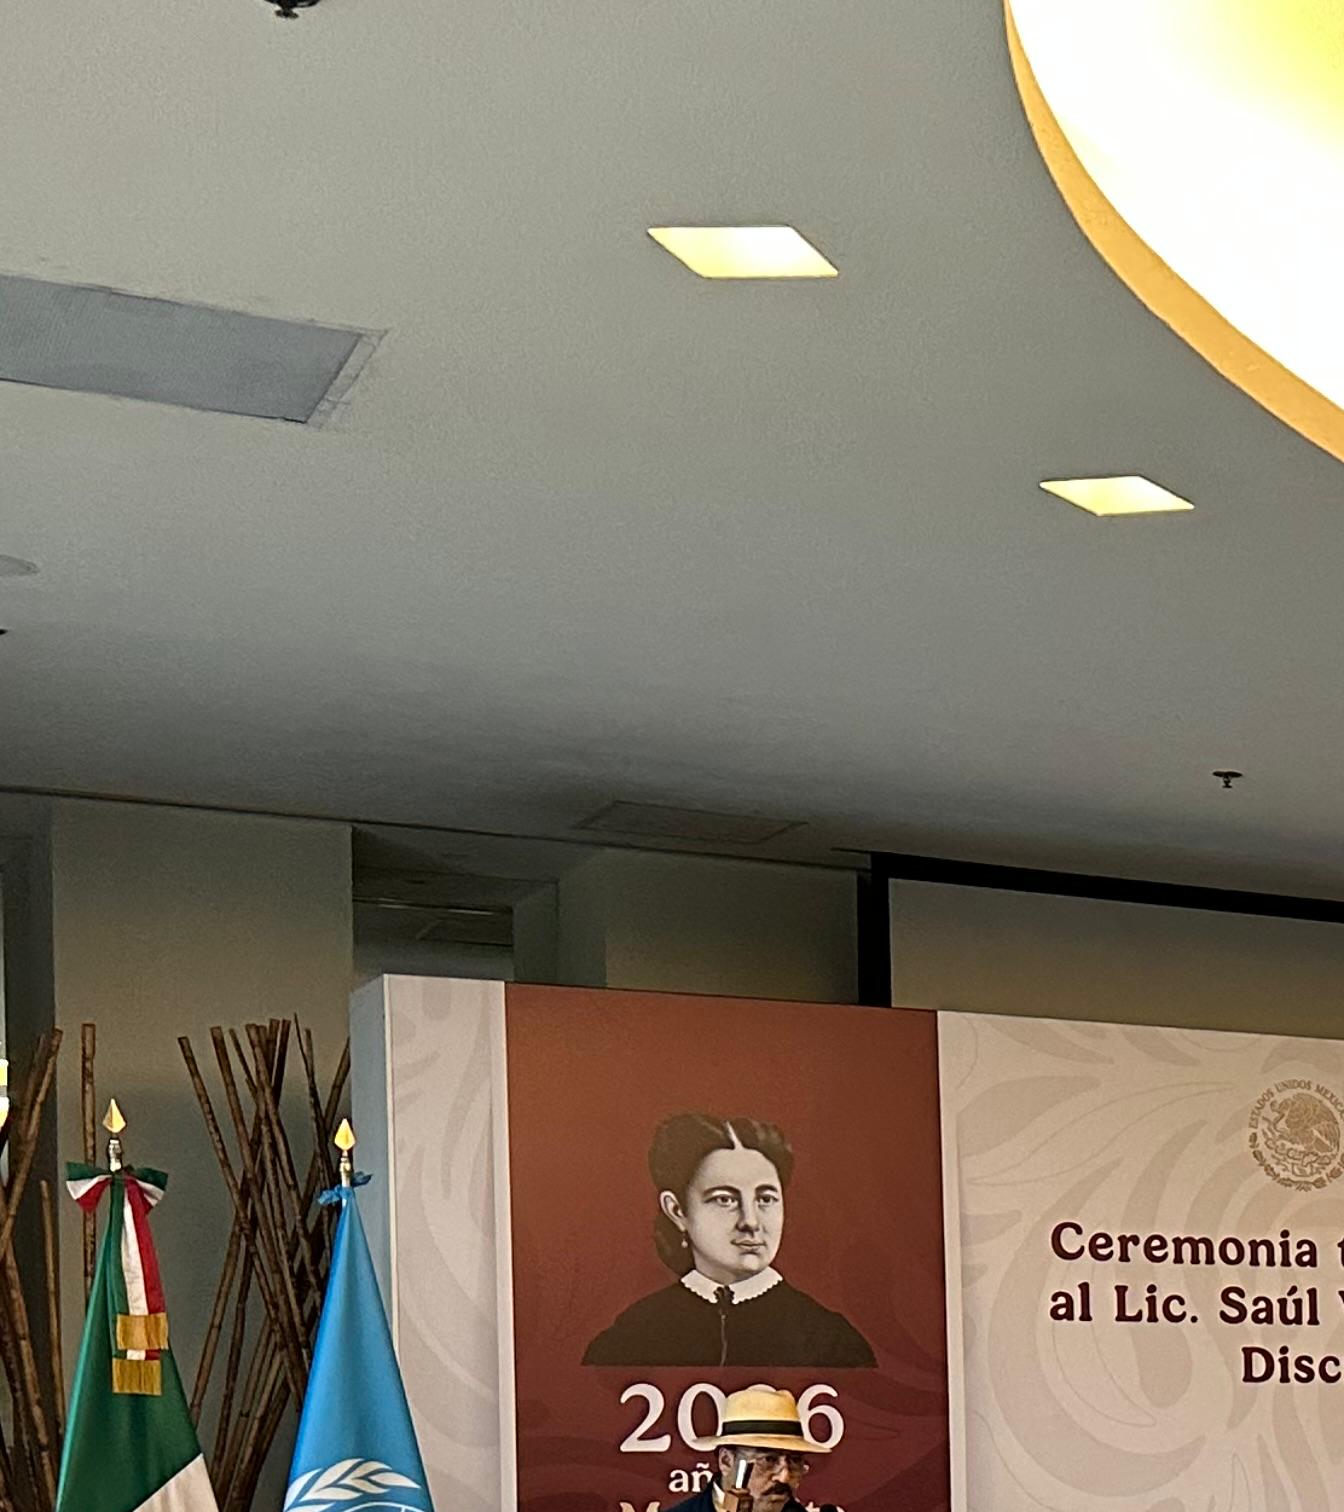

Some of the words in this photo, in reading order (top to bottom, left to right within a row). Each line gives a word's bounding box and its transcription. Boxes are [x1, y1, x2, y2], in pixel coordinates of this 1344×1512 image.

[1249, 1088, 1275, 1129] ESTADOS
[1275, 1079, 1313, 1092] UNIDOS
[1050, 1221, 1318, 1269] Ceremonia
[1049, 1281, 1094, 1323] al
[1113, 1283, 1199, 1324] Lic.
[1218, 1284, 1321, 1327] Saúl
[619, 1382, 845, 1453] 206
[667, 1462, 715, 1493] añ
